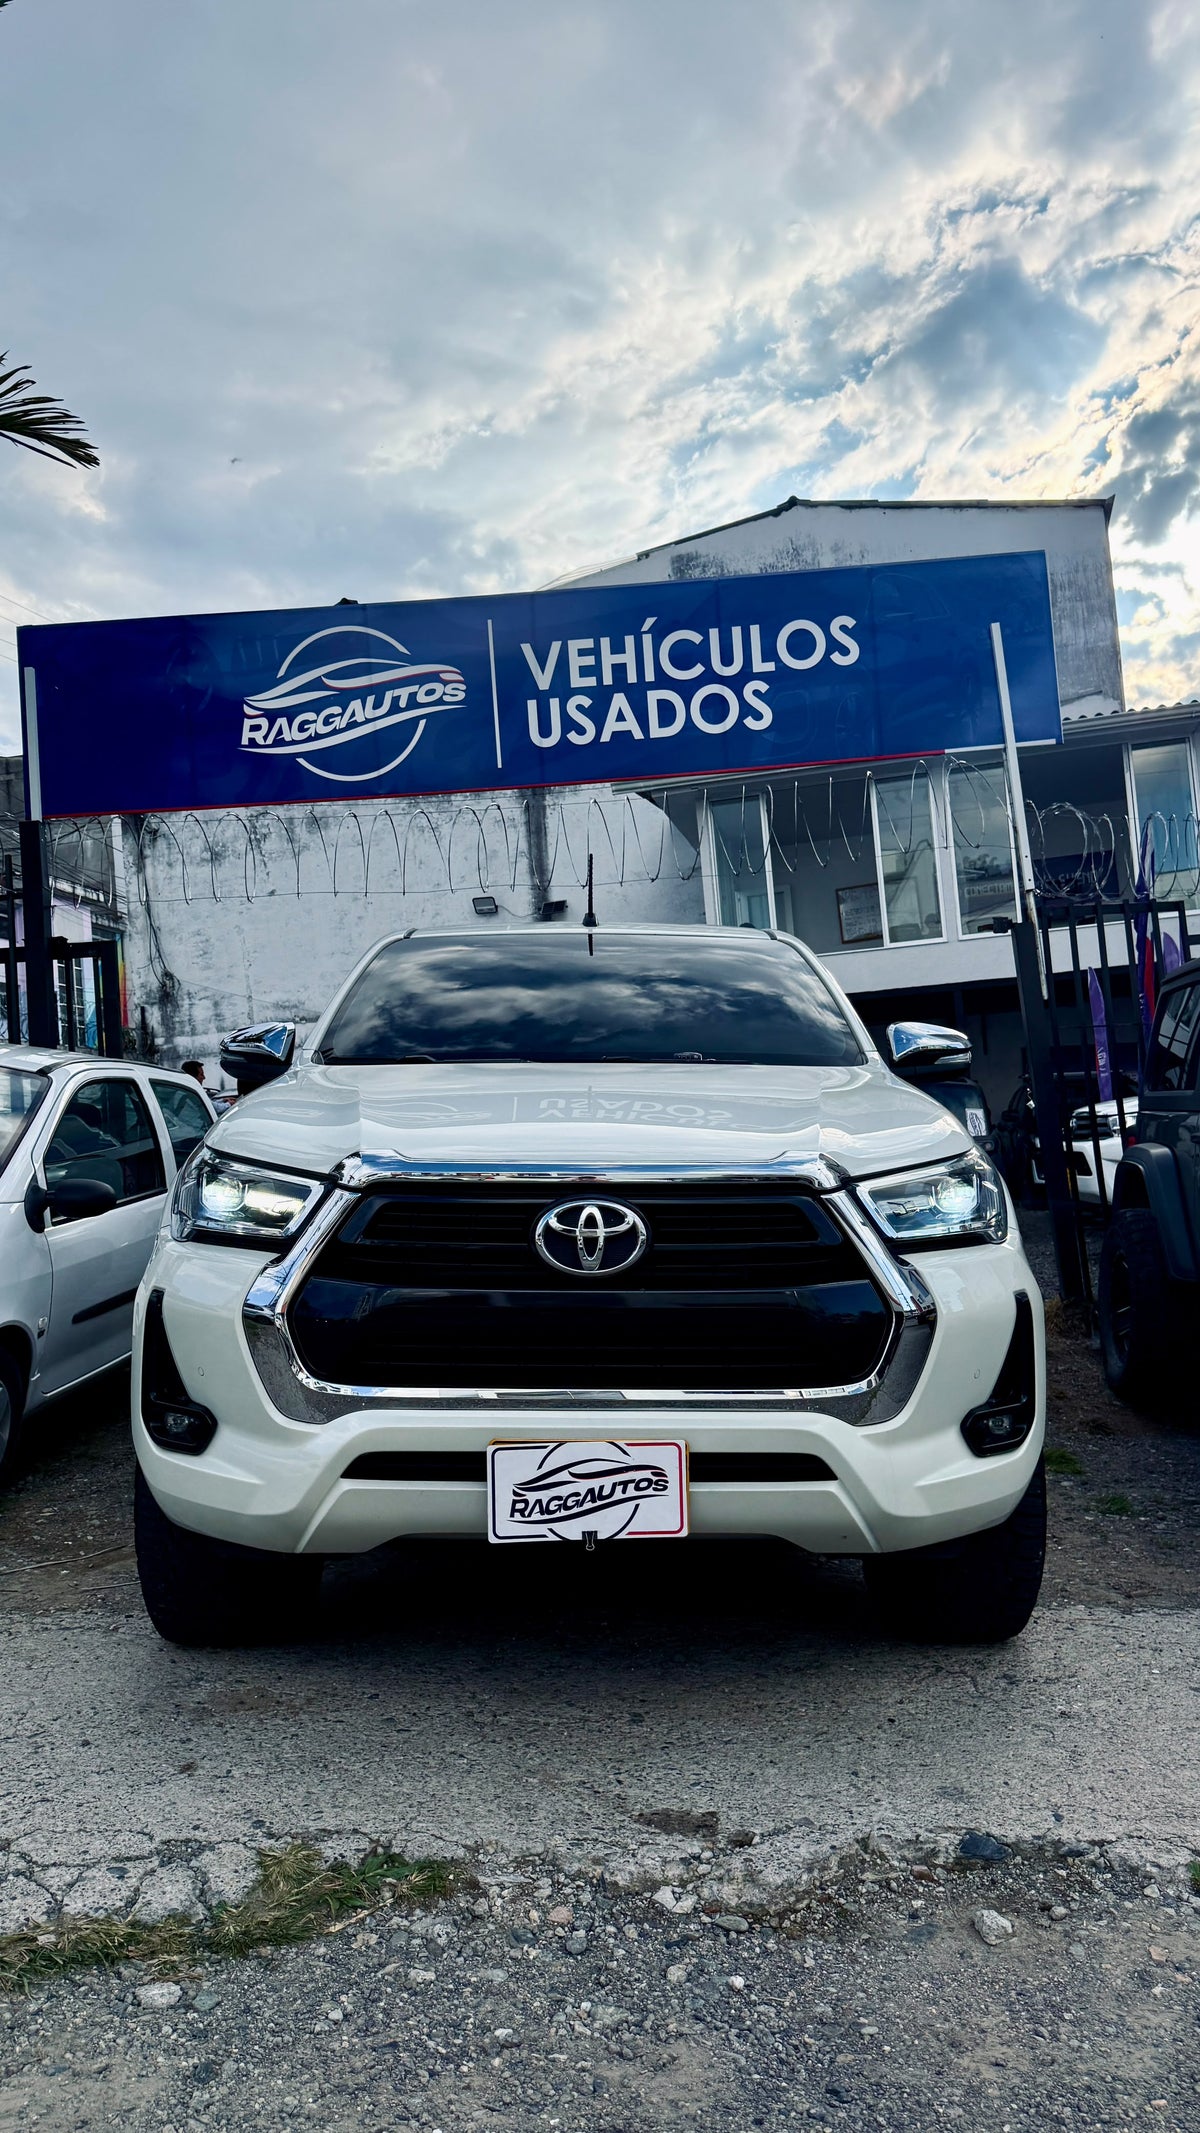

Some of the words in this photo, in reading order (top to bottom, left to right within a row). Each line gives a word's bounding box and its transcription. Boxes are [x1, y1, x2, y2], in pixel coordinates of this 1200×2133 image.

[520, 615, 860, 690] VEHÍCULOS
[241, 682, 467, 746] RAGGAUTOS
[527, 680, 773, 748] USADOS
[509, 1477, 669, 1519] RAGGAUTOS
